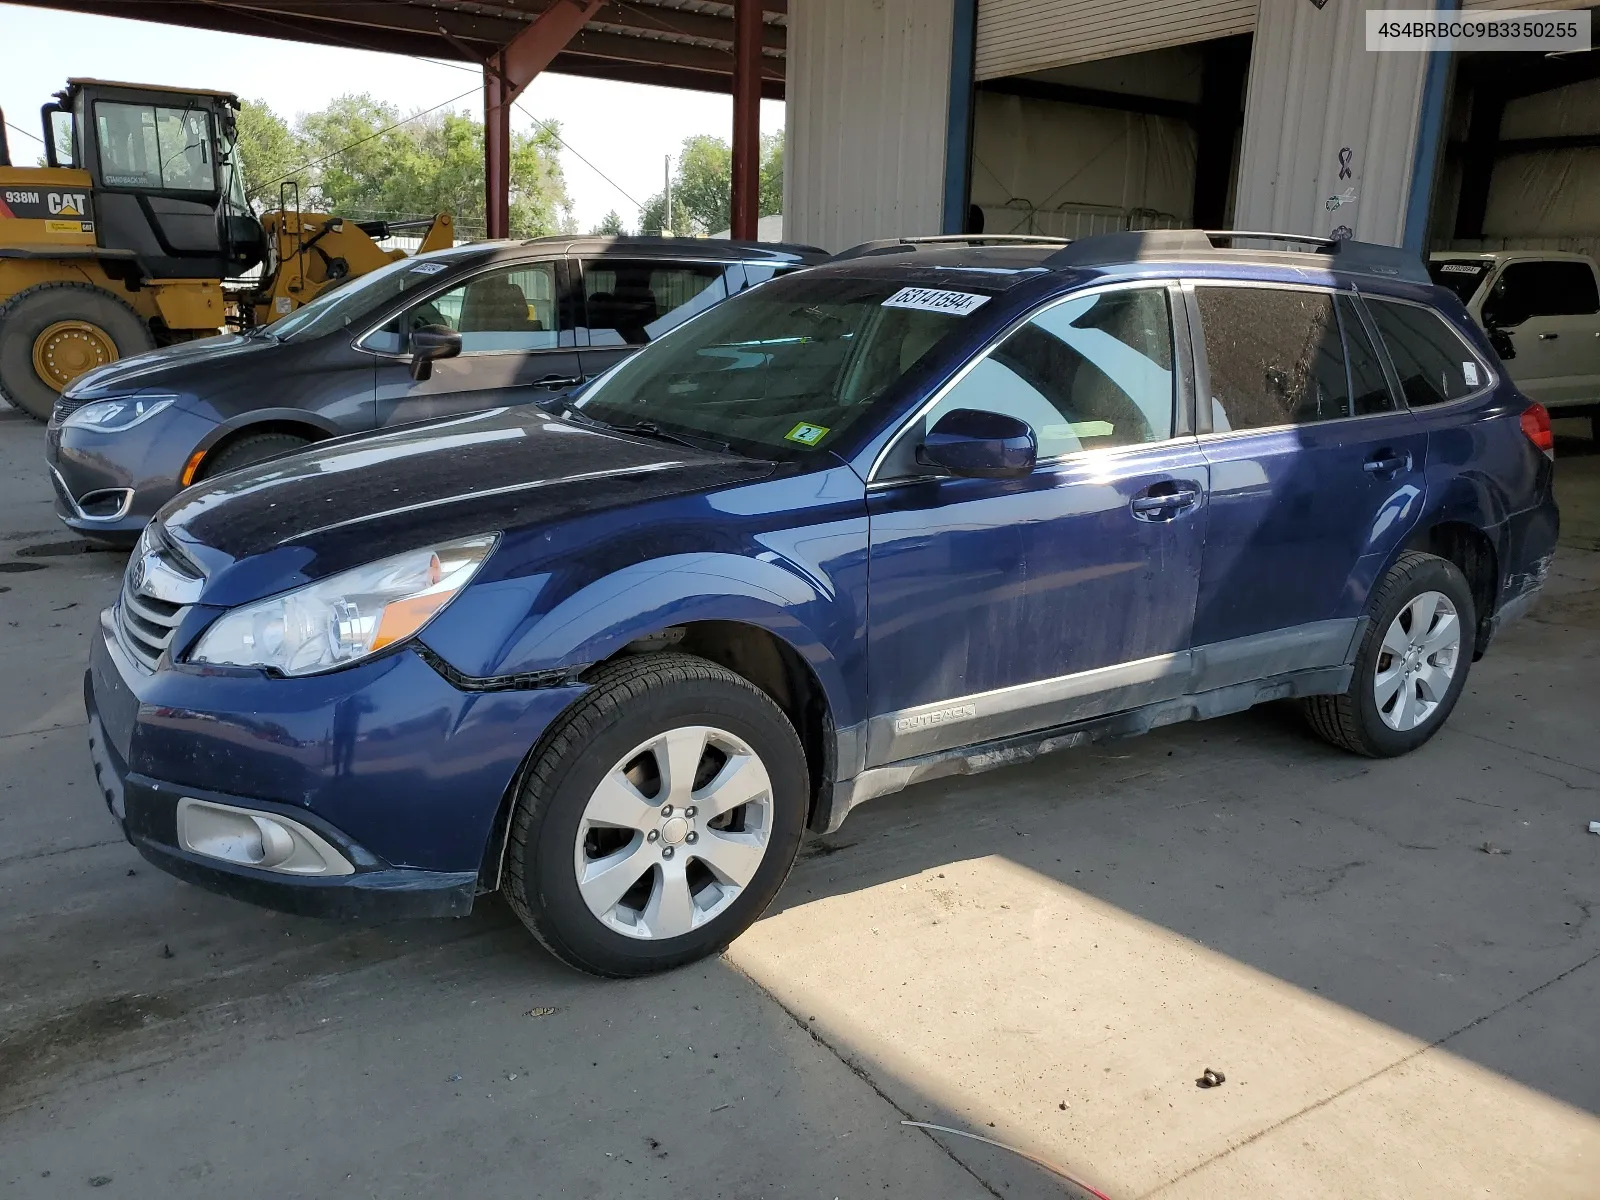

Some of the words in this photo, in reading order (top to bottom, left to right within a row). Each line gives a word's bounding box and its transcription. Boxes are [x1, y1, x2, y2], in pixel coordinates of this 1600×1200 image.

[5, 191, 40, 204] 938M
[47, 192, 86, 215] CAT
[896, 288, 973, 309] 63141594
[798, 427, 812, 438] 2
[897, 706, 974, 730] OUTBACK
